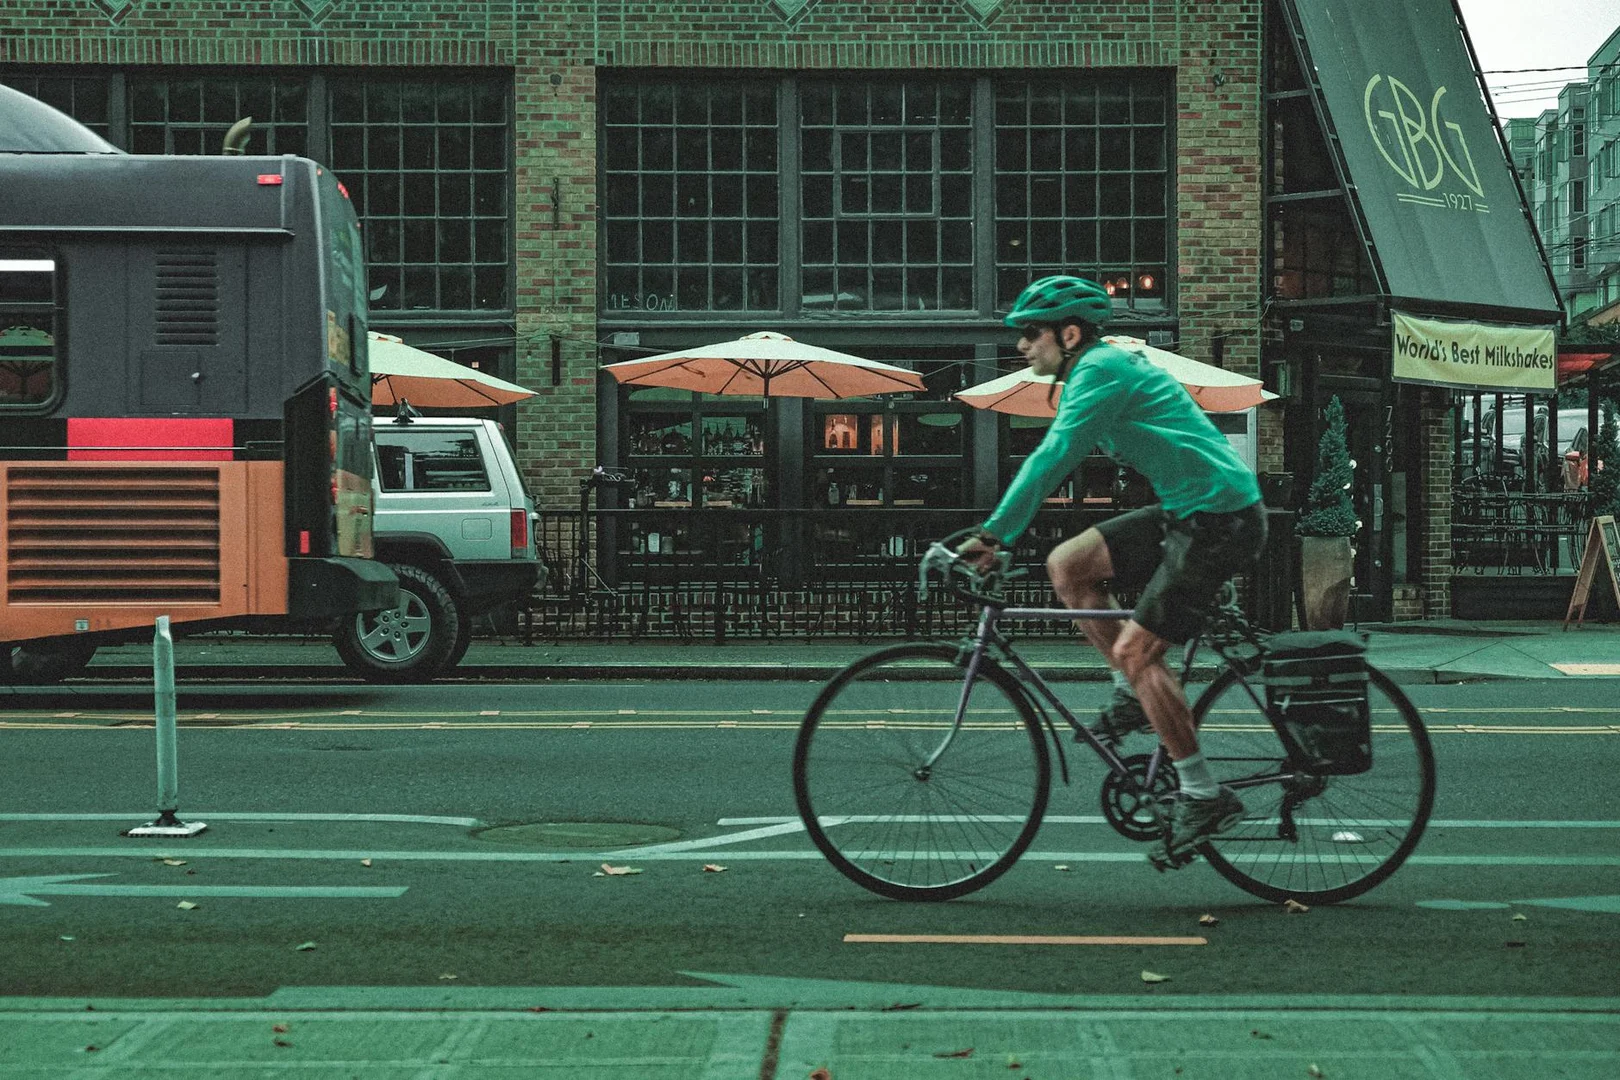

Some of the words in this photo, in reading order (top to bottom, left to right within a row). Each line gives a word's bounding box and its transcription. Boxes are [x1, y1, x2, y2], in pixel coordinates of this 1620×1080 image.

[1443, 193, 1473, 211] 1927
[1396, 333, 1447, 362] World's
[1452, 341, 1479, 365] Best
[1485, 345, 1553, 369] Milkshakes
[1385, 405, 1393, 473] 7200
